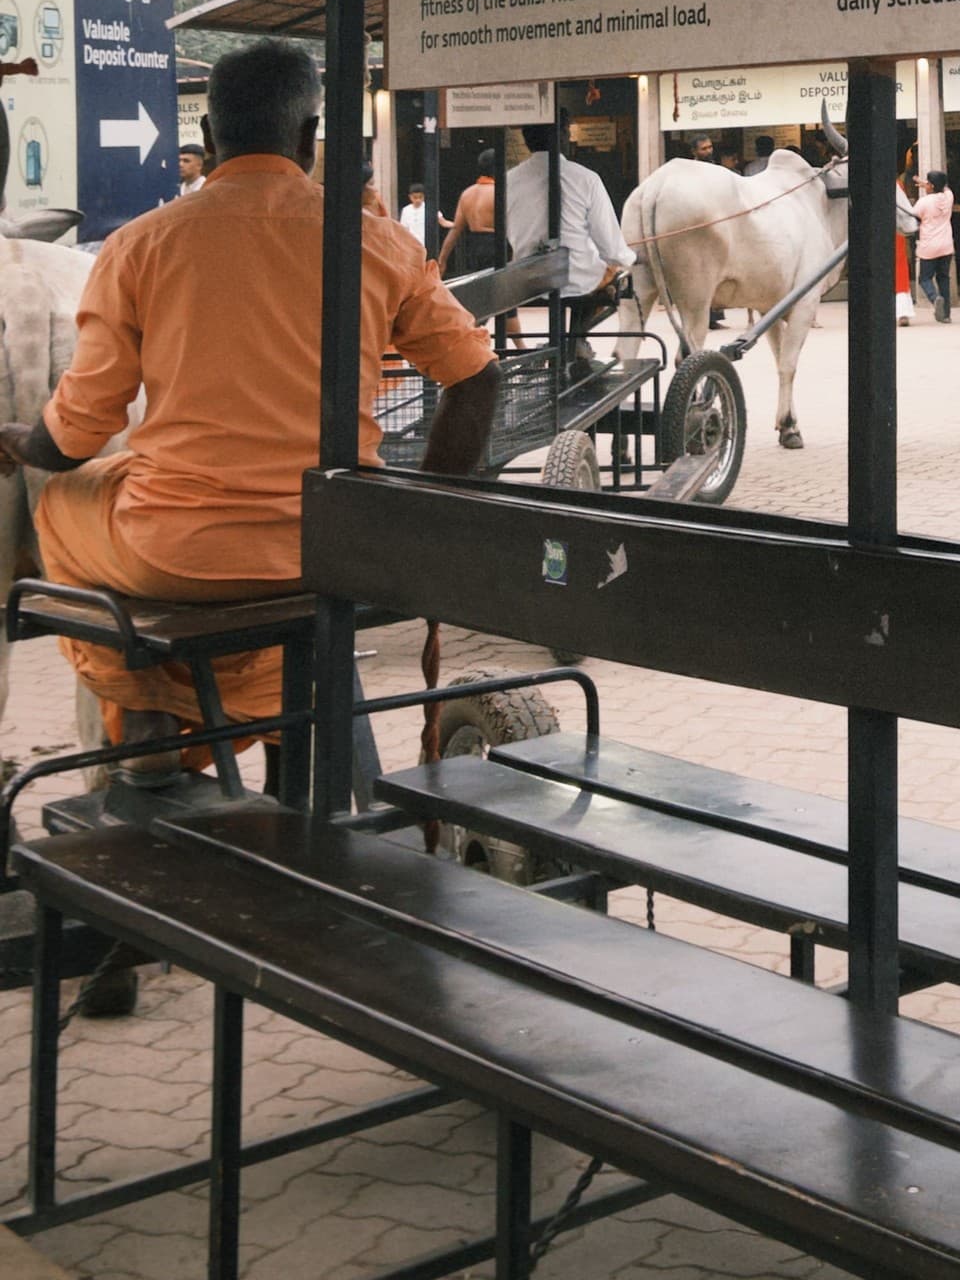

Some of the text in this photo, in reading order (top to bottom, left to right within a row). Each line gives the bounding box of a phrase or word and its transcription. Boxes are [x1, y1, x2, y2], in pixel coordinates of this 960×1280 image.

[83, 18, 130, 42] Valuable
[421, 2, 710, 53] for smooth movement and minimal load,
[83, 45, 169, 70] Deposit Counter
[800, 85, 846, 98] DEPOSIT
